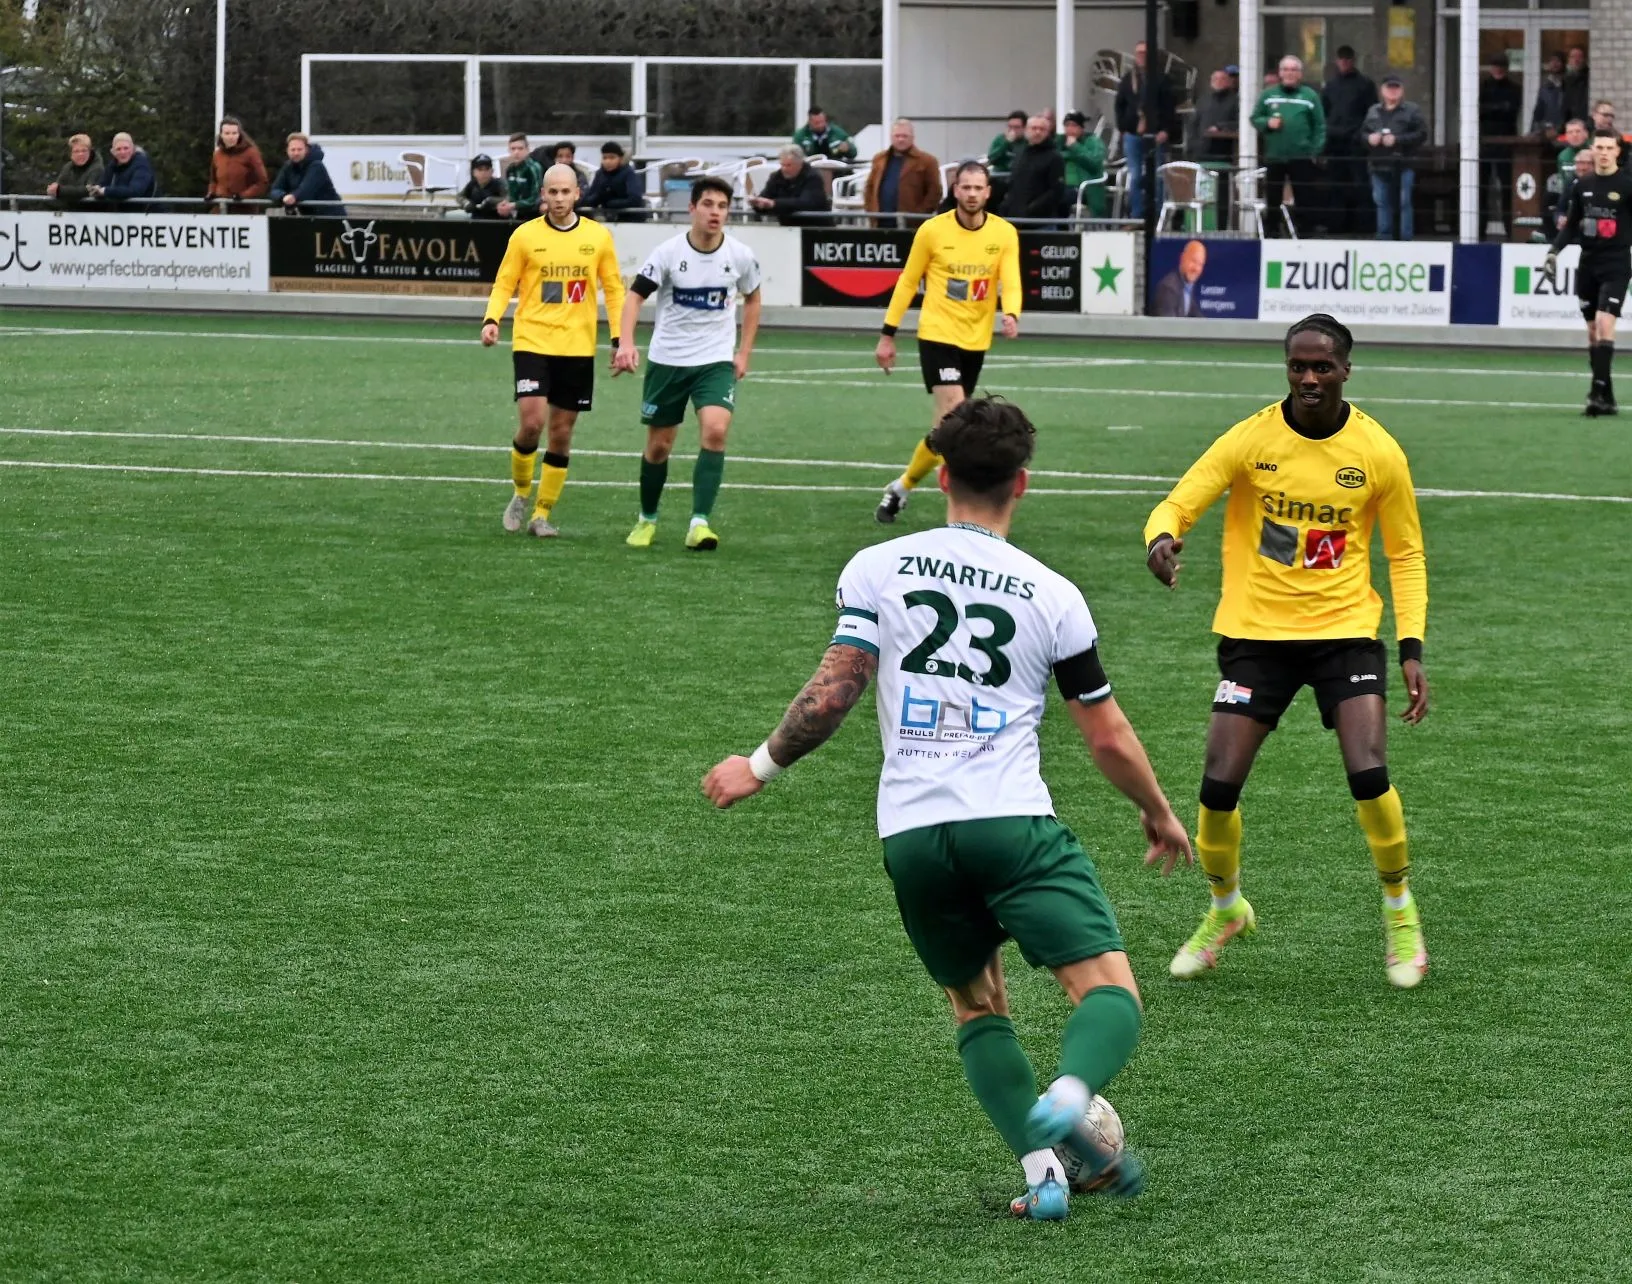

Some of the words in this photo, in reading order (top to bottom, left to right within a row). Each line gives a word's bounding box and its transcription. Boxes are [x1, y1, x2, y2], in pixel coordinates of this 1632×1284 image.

[49, 224, 250, 249] BRANDPREVENTIE
[315, 232, 345, 259] LA
[379, 234, 481, 262] FAVOLA
[813, 243, 852, 261] NEXT
[856, 244, 901, 263] LEVEL
[1040, 246, 1079, 259] GELUID
[50, 259, 251, 281] www.perfectbrandpreventie.nl
[315, 264, 355, 274] SLAGERIJ
[374, 265, 416, 276] TRAITEUR
[435, 266, 480, 277] CATERING
[540, 261, 589, 278] simac
[679, 260, 688, 272] 8
[947, 262, 993, 276] simac
[1284, 250, 1426, 292] zuidlease
[1041, 286, 1075, 300] BEELD
[1255, 462, 1278, 472] JAKO
[1261, 492, 1353, 525] simac
[897, 556, 1036, 601] ZWARTJES
[900, 589, 1017, 688] 23
[899, 728, 934, 738] BRULS
[897, 748, 941, 759] RUTTEN
